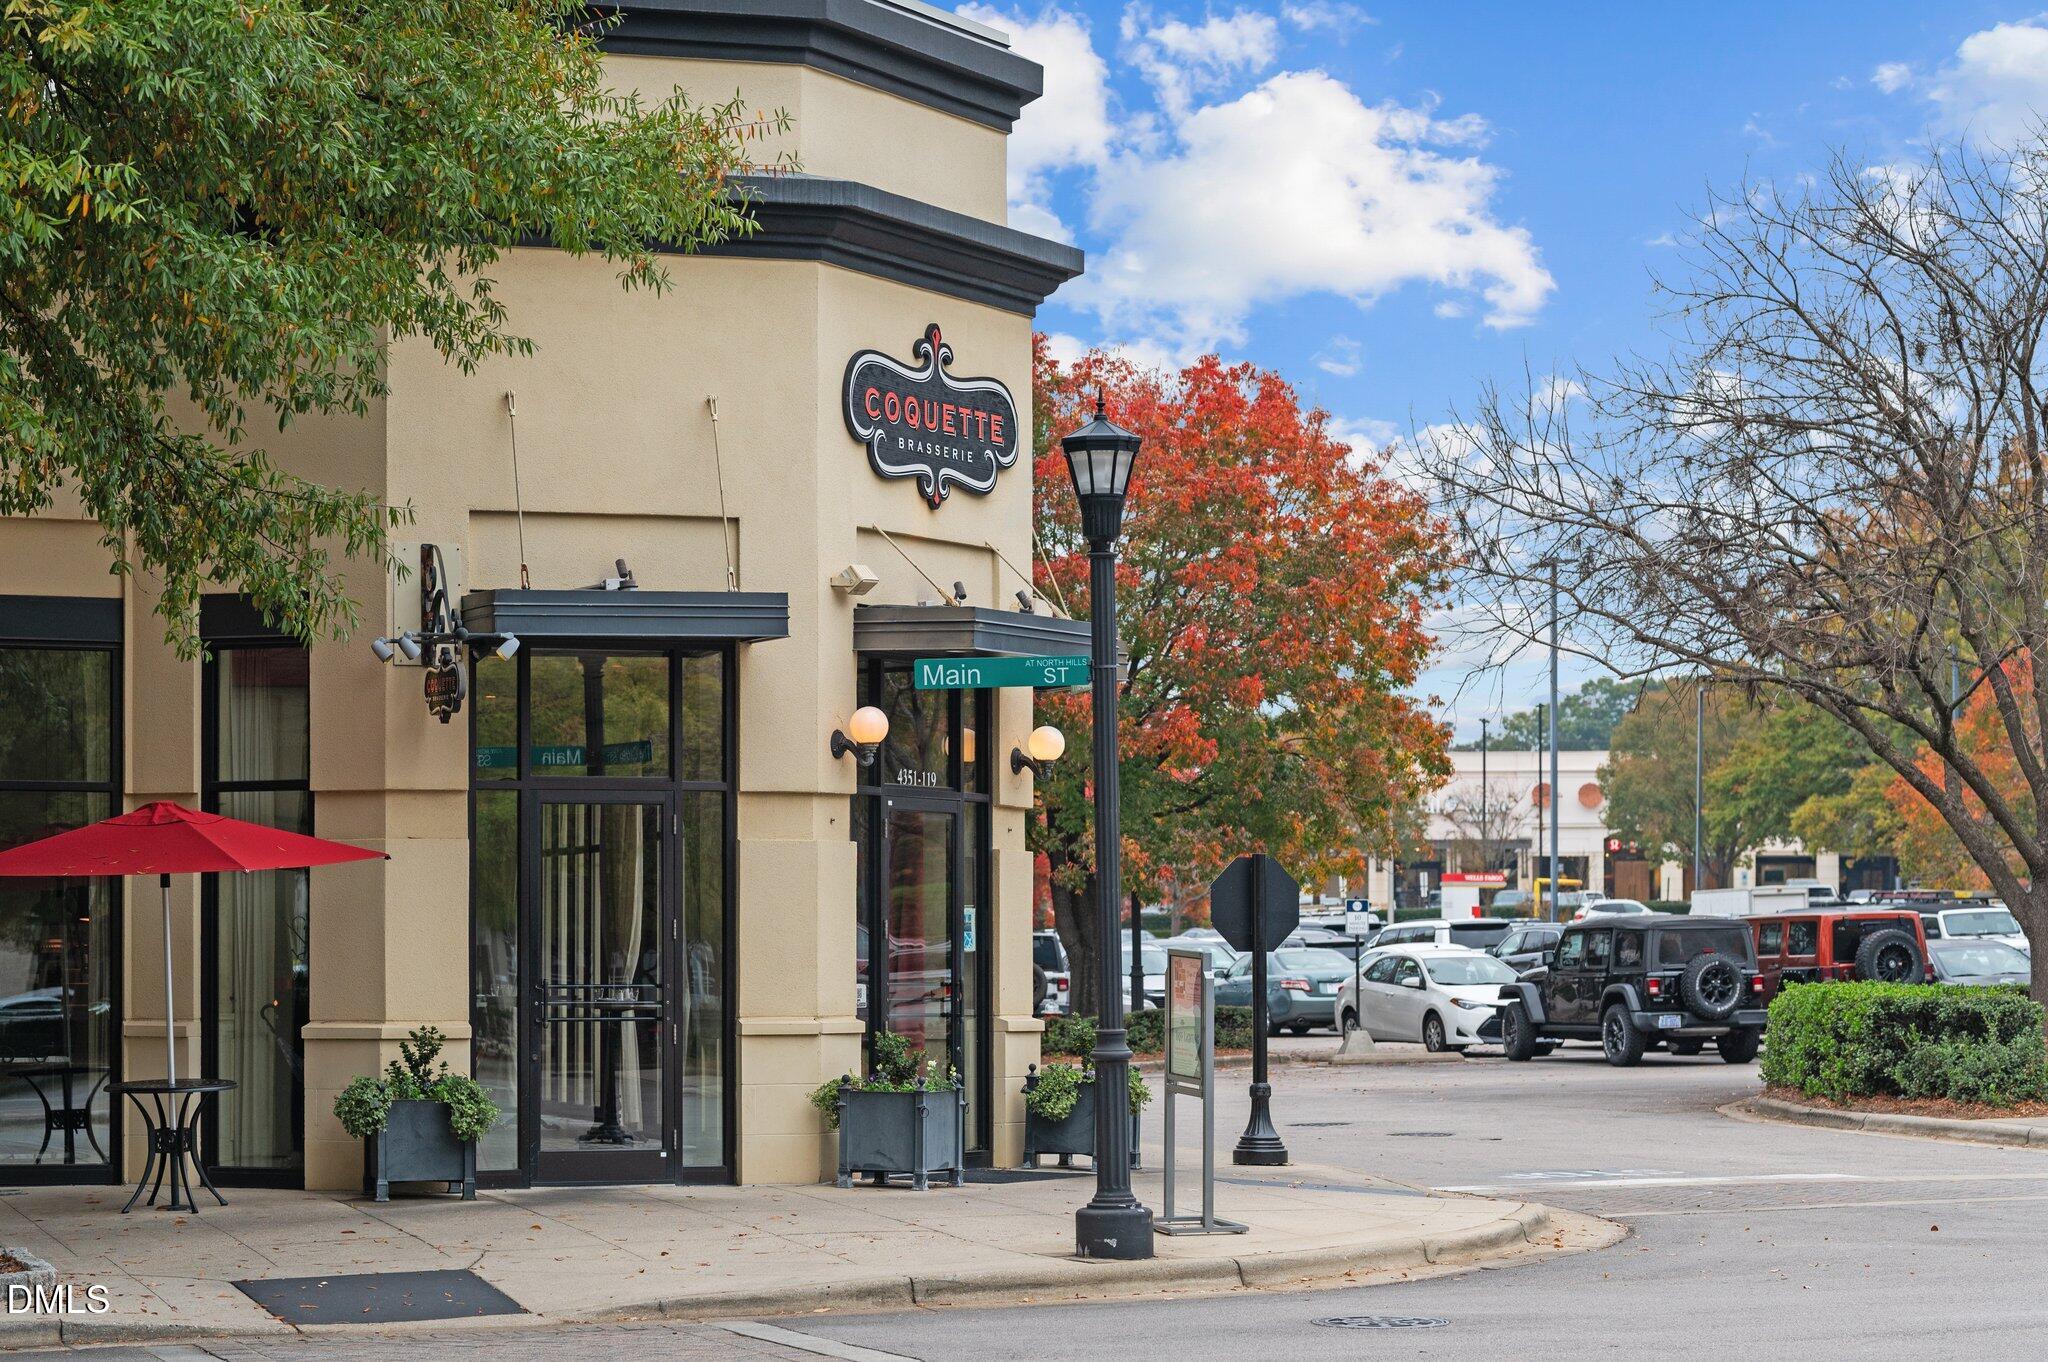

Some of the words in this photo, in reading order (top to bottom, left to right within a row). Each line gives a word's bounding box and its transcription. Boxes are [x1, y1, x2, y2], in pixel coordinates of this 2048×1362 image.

[865, 387, 1005, 447] COQUETTE
[898, 437, 973, 463] BRASSERIE
[1037, 659, 1063, 667] NORTH
[1066, 658, 1087, 666] HILLS
[923, 664, 981, 686] Main
[1044, 667, 1069, 684] ST
